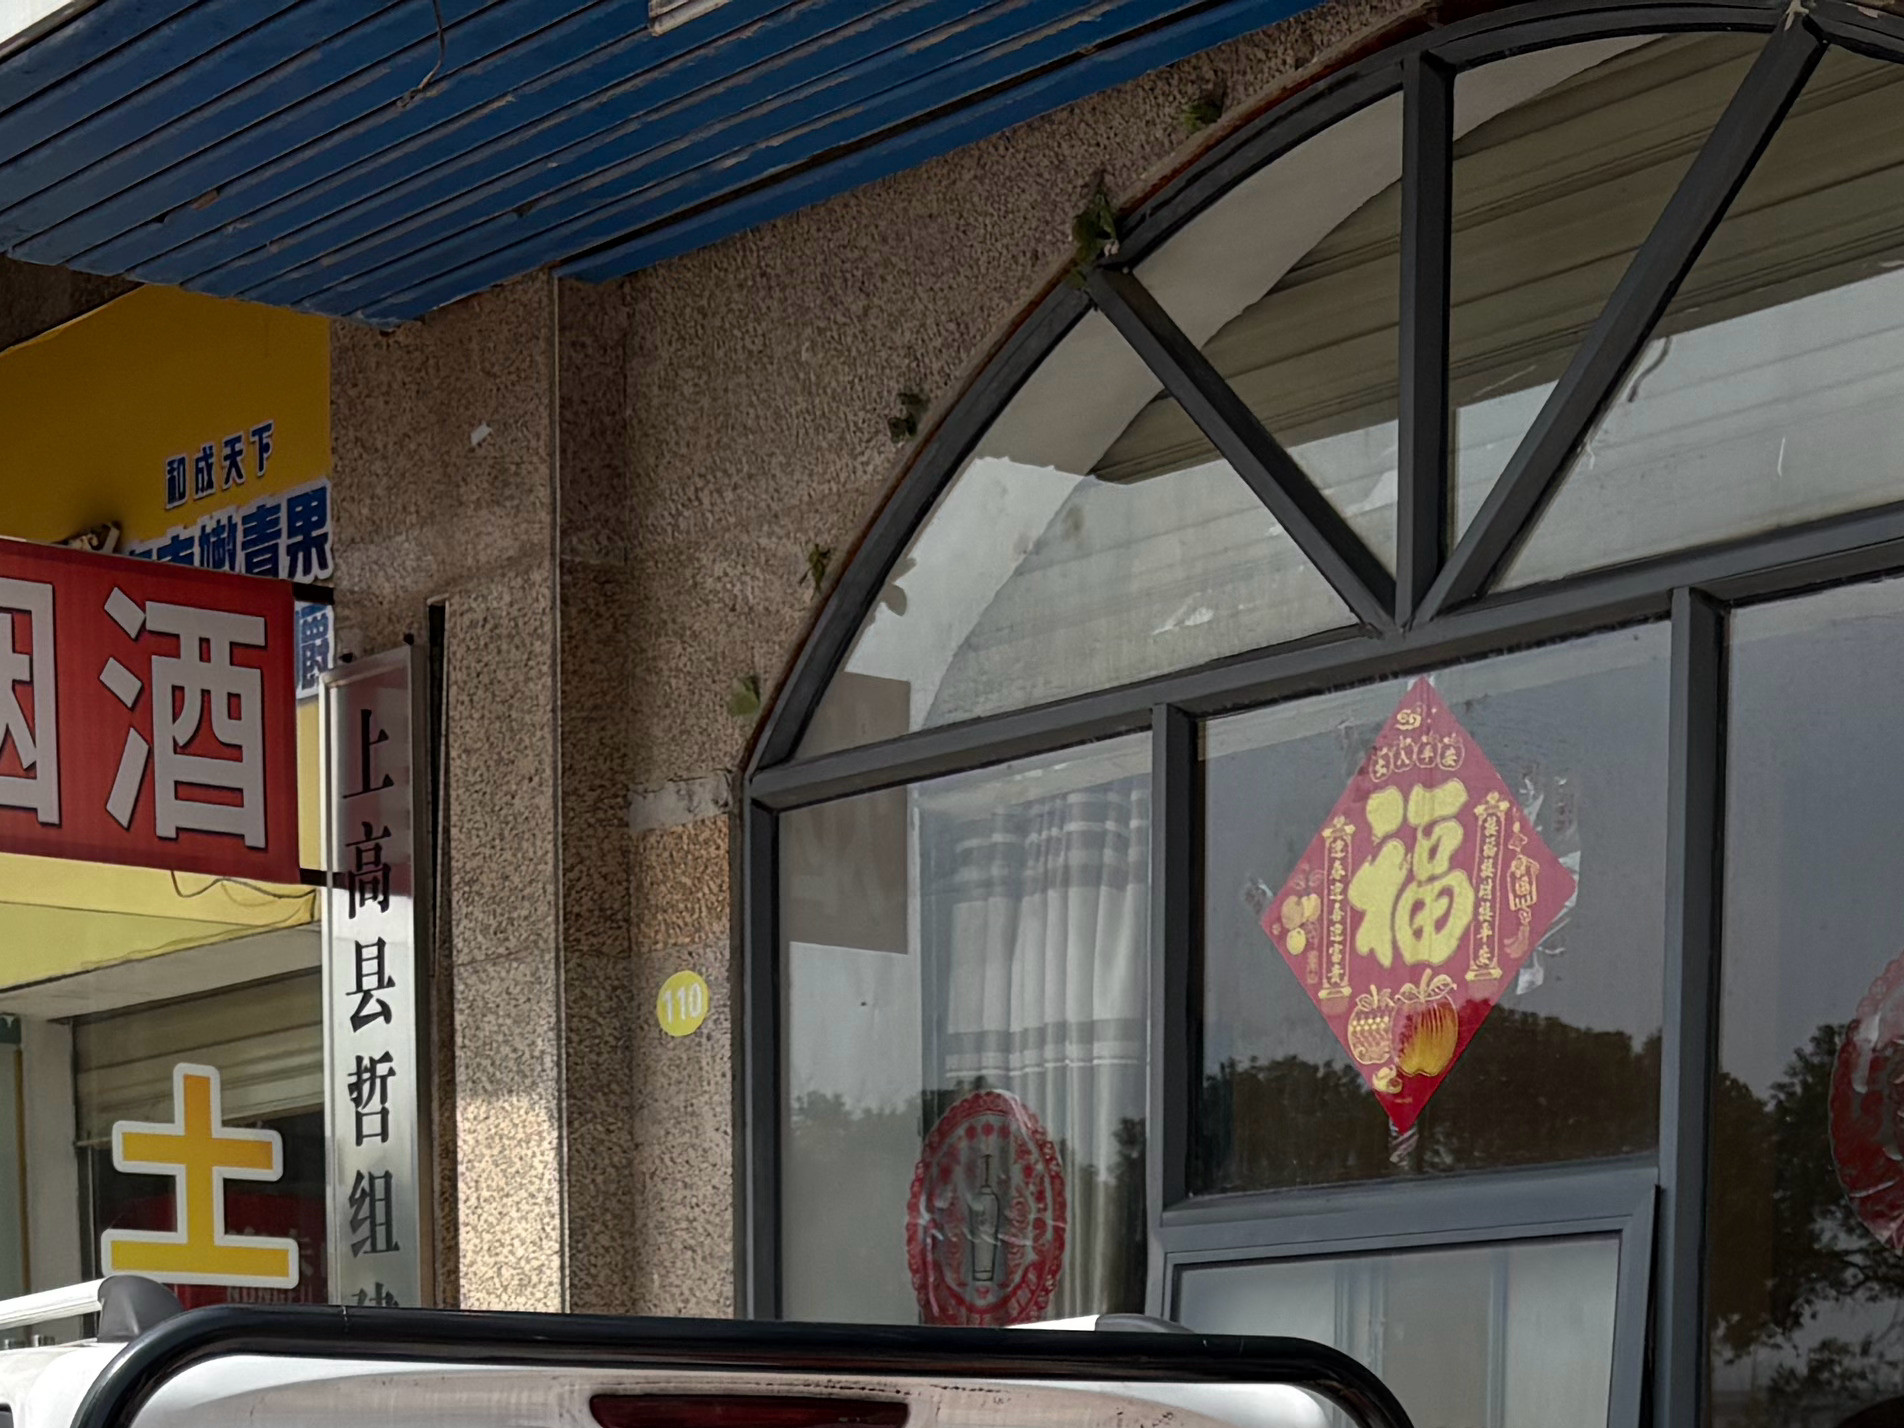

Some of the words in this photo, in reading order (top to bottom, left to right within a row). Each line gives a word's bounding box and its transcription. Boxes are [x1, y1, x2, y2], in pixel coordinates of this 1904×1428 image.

[164, 421, 275, 509] 和成天下
[1349, 779, 1471, 970] 福
[101, 1062, 300, 1289] 土
